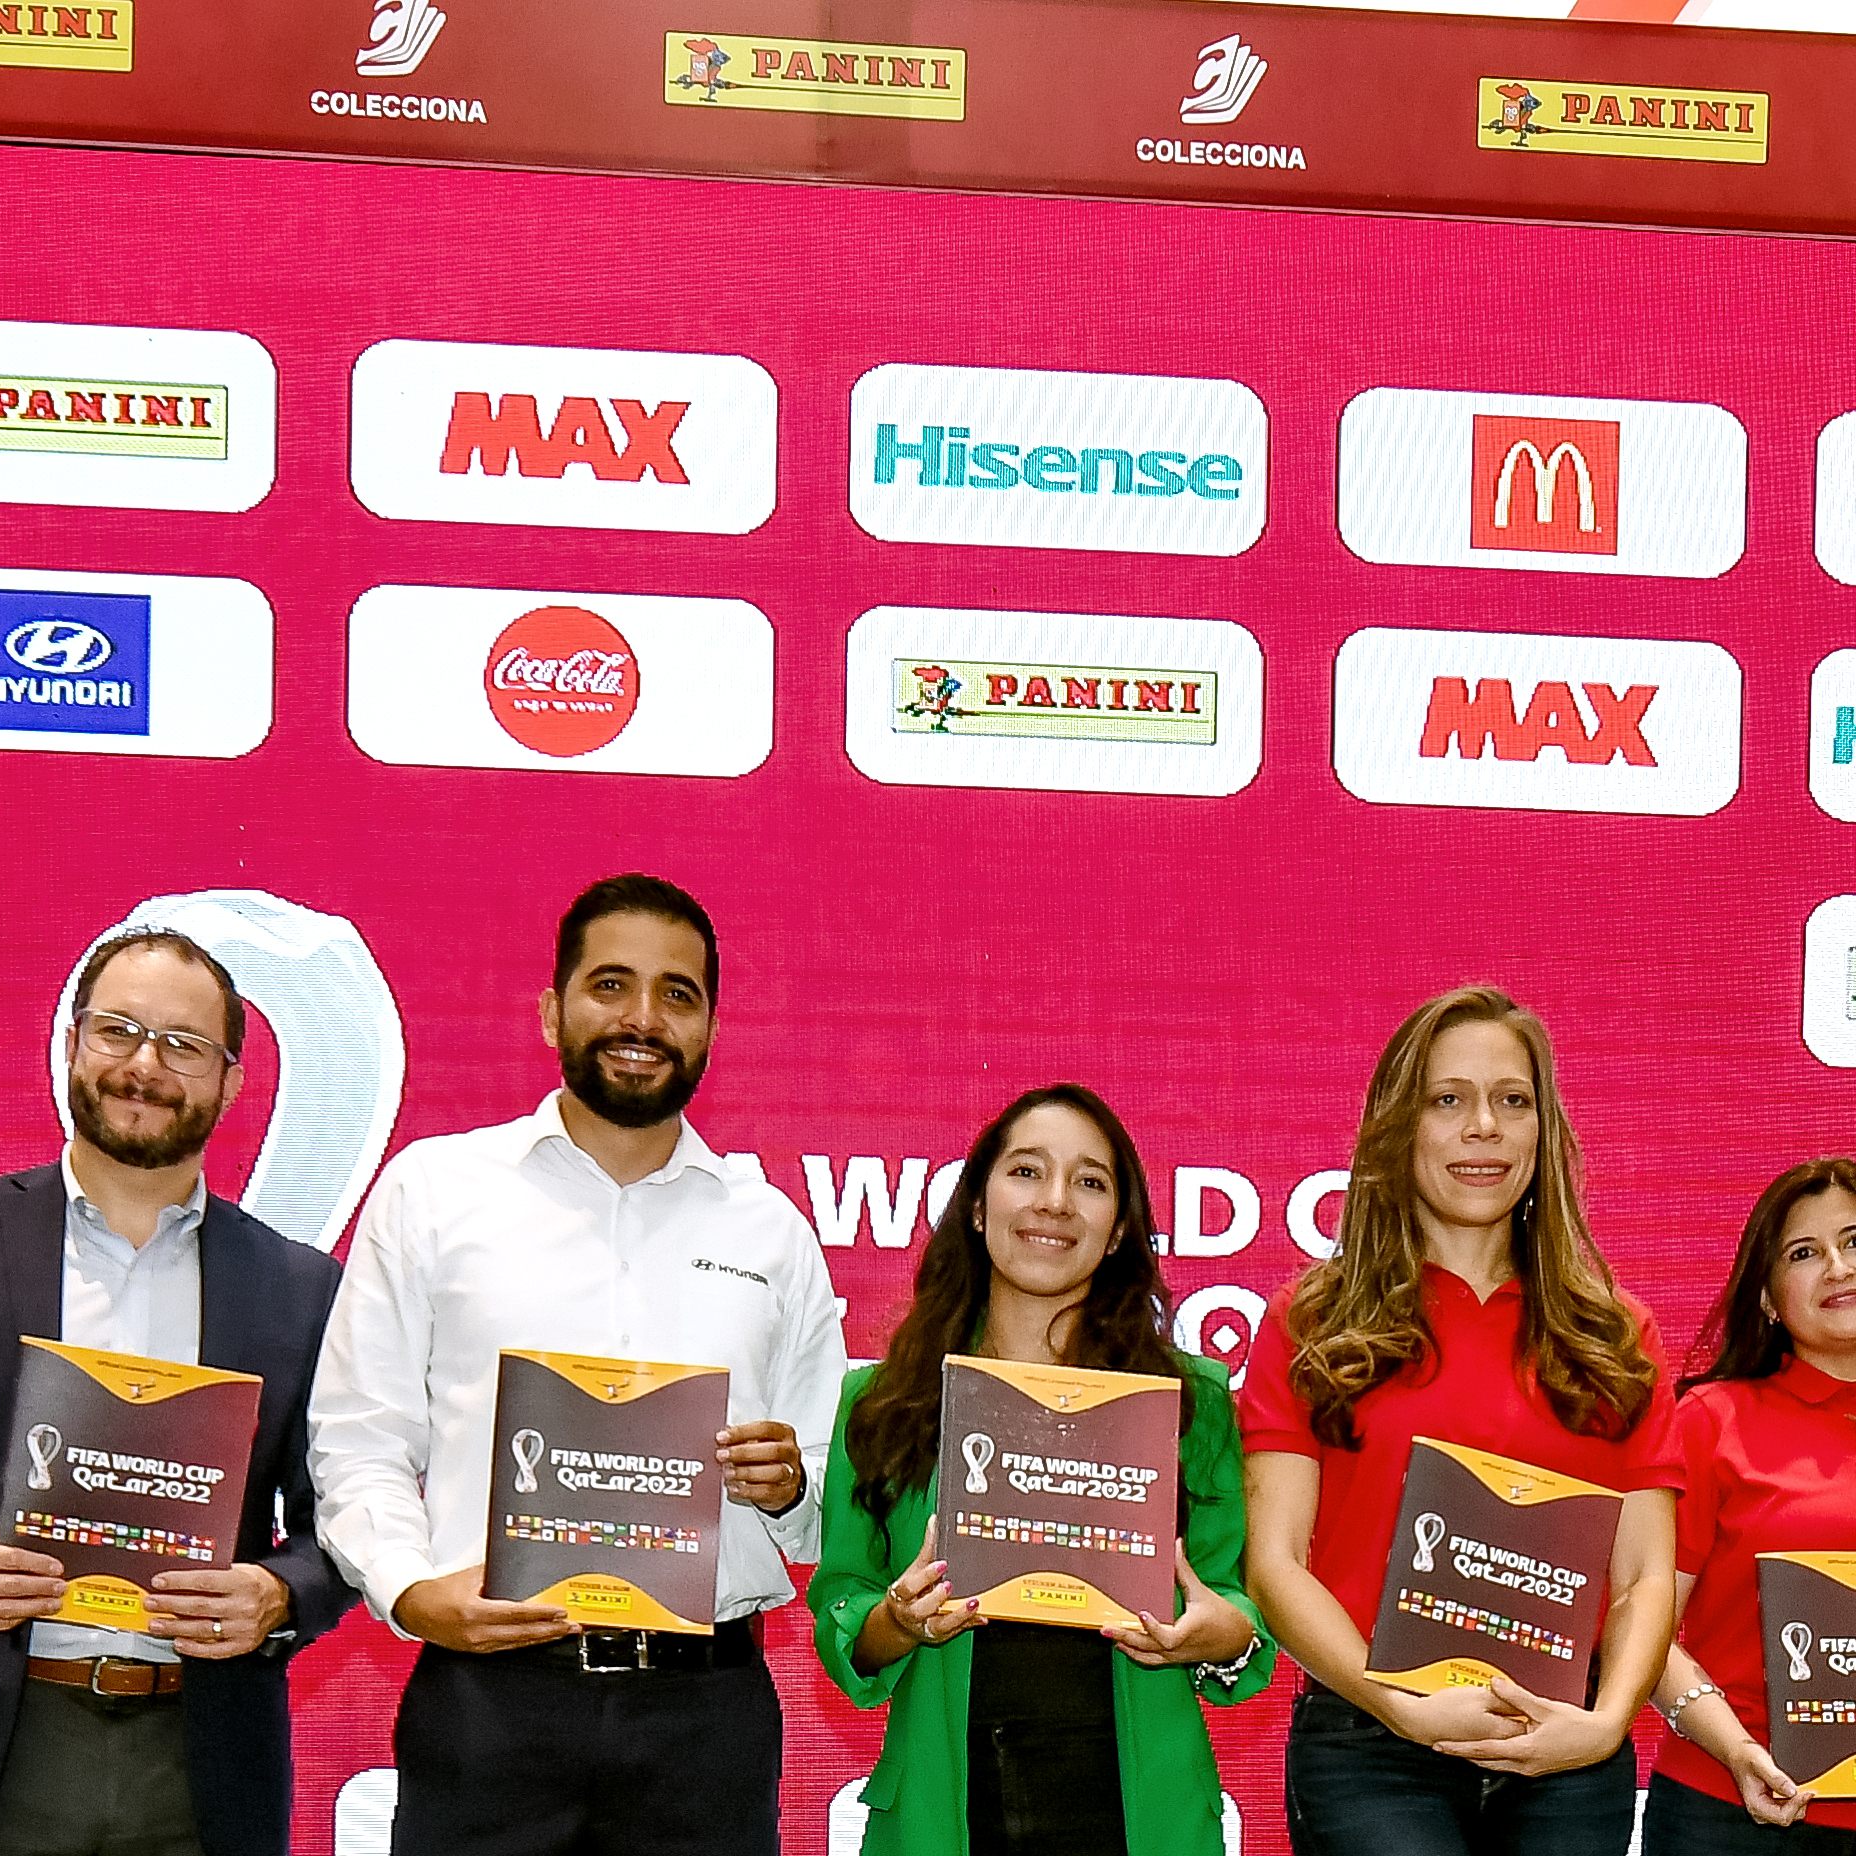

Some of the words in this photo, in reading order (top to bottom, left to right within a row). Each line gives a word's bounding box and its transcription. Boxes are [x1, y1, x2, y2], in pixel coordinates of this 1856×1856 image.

[751, 47, 952, 90] PANINI
[310, 90, 487, 125] COLECCIONA
[1560, 92, 1755, 134] PANINI
[1136, 136, 1307, 172] COLECCIONA
[440, 392, 690, 487] MAX
[874, 424, 1243, 501] Hisense
[986, 674, 1201, 715] PANINI
[1419, 676, 1659, 768] MAX
[66, 1446, 111, 1469] FIFA
[112, 1452, 183, 1479] WORLD
[185, 1466, 226, 1485] CUP
[550, 1449, 595, 1468] FIFA
[596, 1453, 663, 1475] WORLD
[665, 1458, 704, 1478] CUP
[1001, 1452, 1045, 1472] FIFA
[1046, 1457, 1119, 1480] WORLD
[1119, 1466, 1159, 1485] CUP
[1449, 1535, 1488, 1560] FIFA
[1489, 1546, 1552, 1578] WORLD
[1552, 1567, 1587, 1589] CUP
[1039, 1590, 1084, 1602] PANINI
[1819, 1638, 1856, 1653] FIFA
